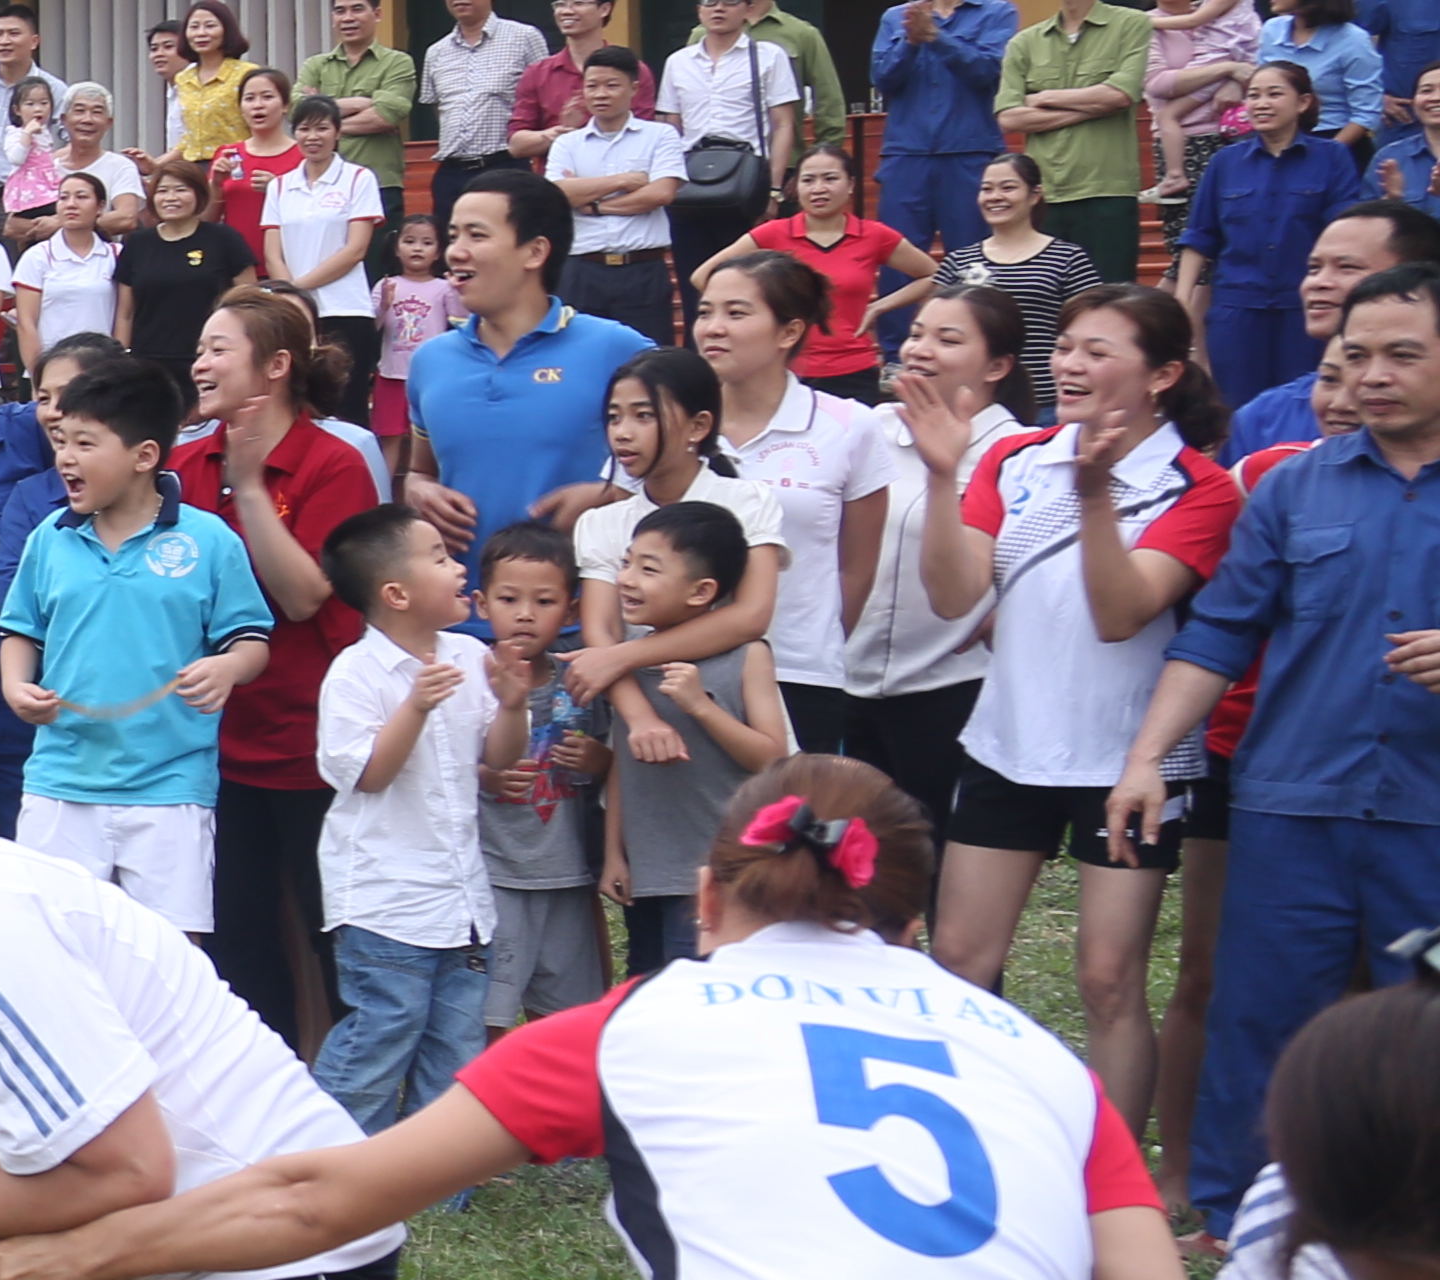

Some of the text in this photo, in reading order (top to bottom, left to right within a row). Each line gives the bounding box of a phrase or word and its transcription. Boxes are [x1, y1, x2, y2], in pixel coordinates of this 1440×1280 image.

[533, 367, 563, 383] CK
[697, 974, 1023, 1038] ĐƠN VỊ A3
[799, 1022, 997, 1258] 5
